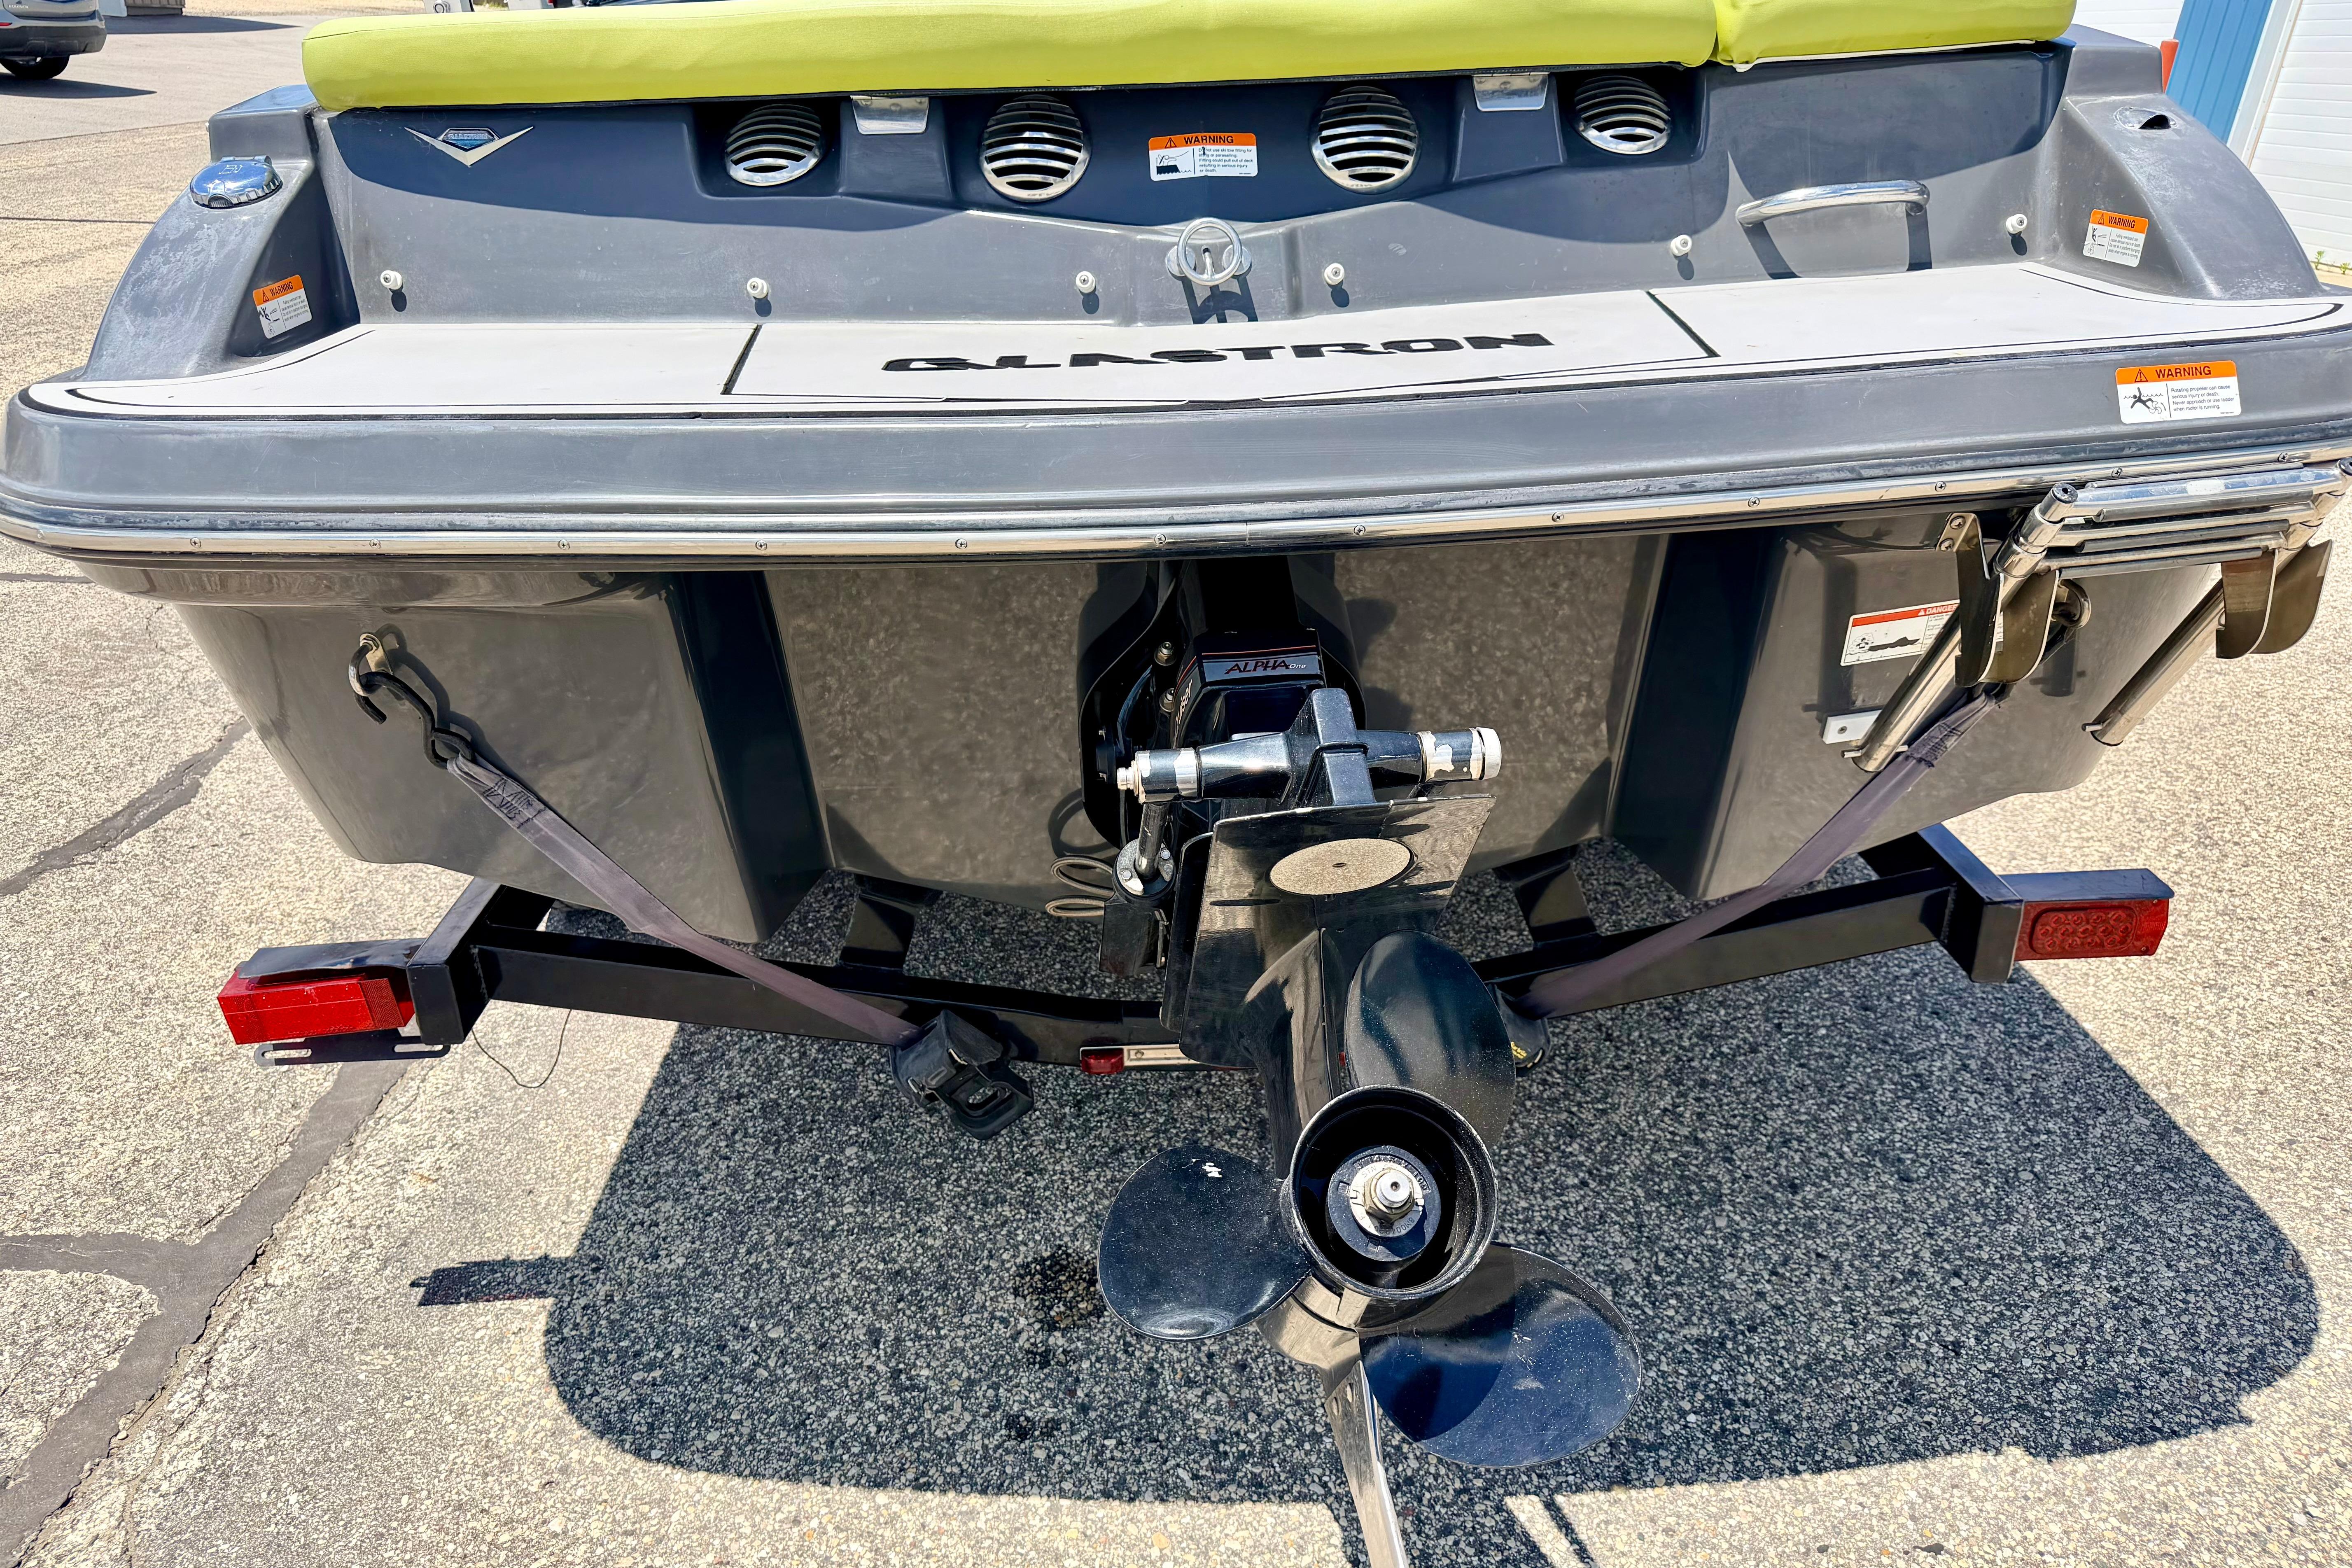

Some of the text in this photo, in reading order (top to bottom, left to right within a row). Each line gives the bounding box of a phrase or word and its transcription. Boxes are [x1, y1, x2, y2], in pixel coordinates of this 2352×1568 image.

[1184, 135, 1234, 145] WARNING
[2109, 216, 2135, 228] WARNING
[270, 281, 293, 296] WARNING
[882, 333, 1554, 371] GLASTRON
[2155, 366, 2211, 379] WARNING
[1224, 660, 1290, 674] ALPHA
